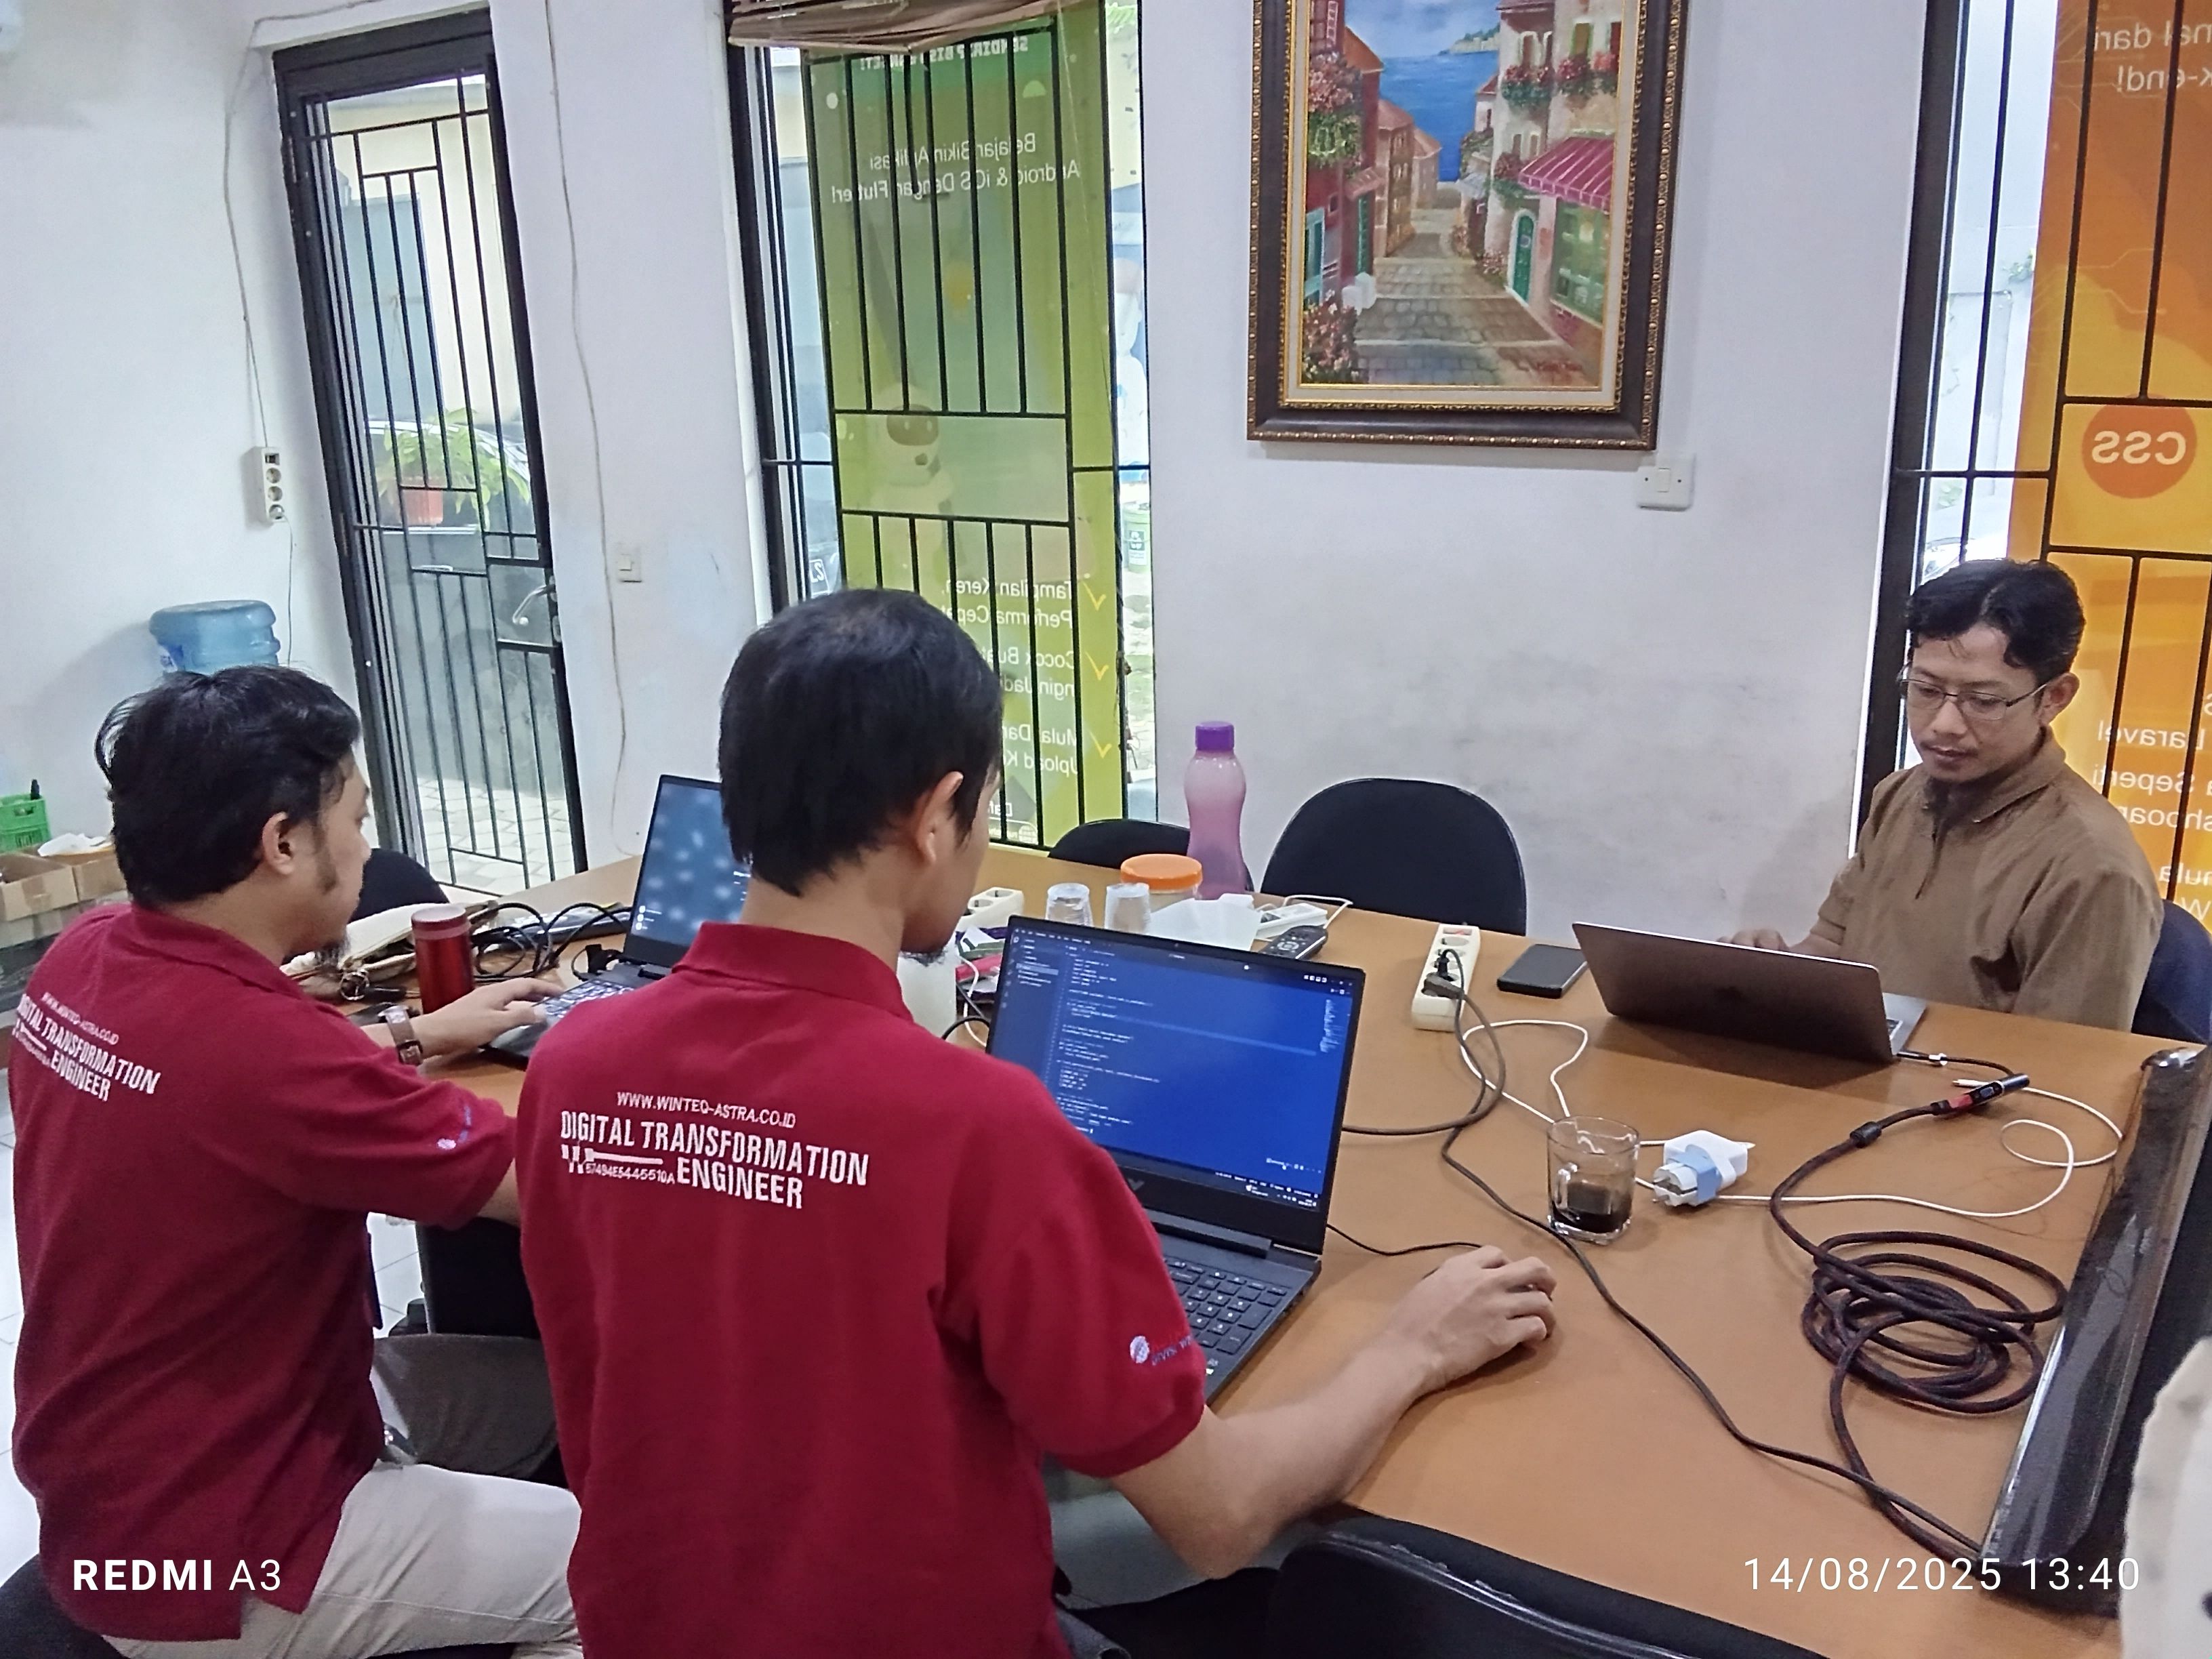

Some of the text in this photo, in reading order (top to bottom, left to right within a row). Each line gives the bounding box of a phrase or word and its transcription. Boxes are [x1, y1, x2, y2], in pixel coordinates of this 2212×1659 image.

[41, 1017, 162, 1095] TRANSFORMATION
[50, 1052, 111, 1102] ENGINEER
[560, 1110, 869, 1186] DIGITAL TRANSFORMATION
[677, 1157, 803, 1209] ENGINEER
